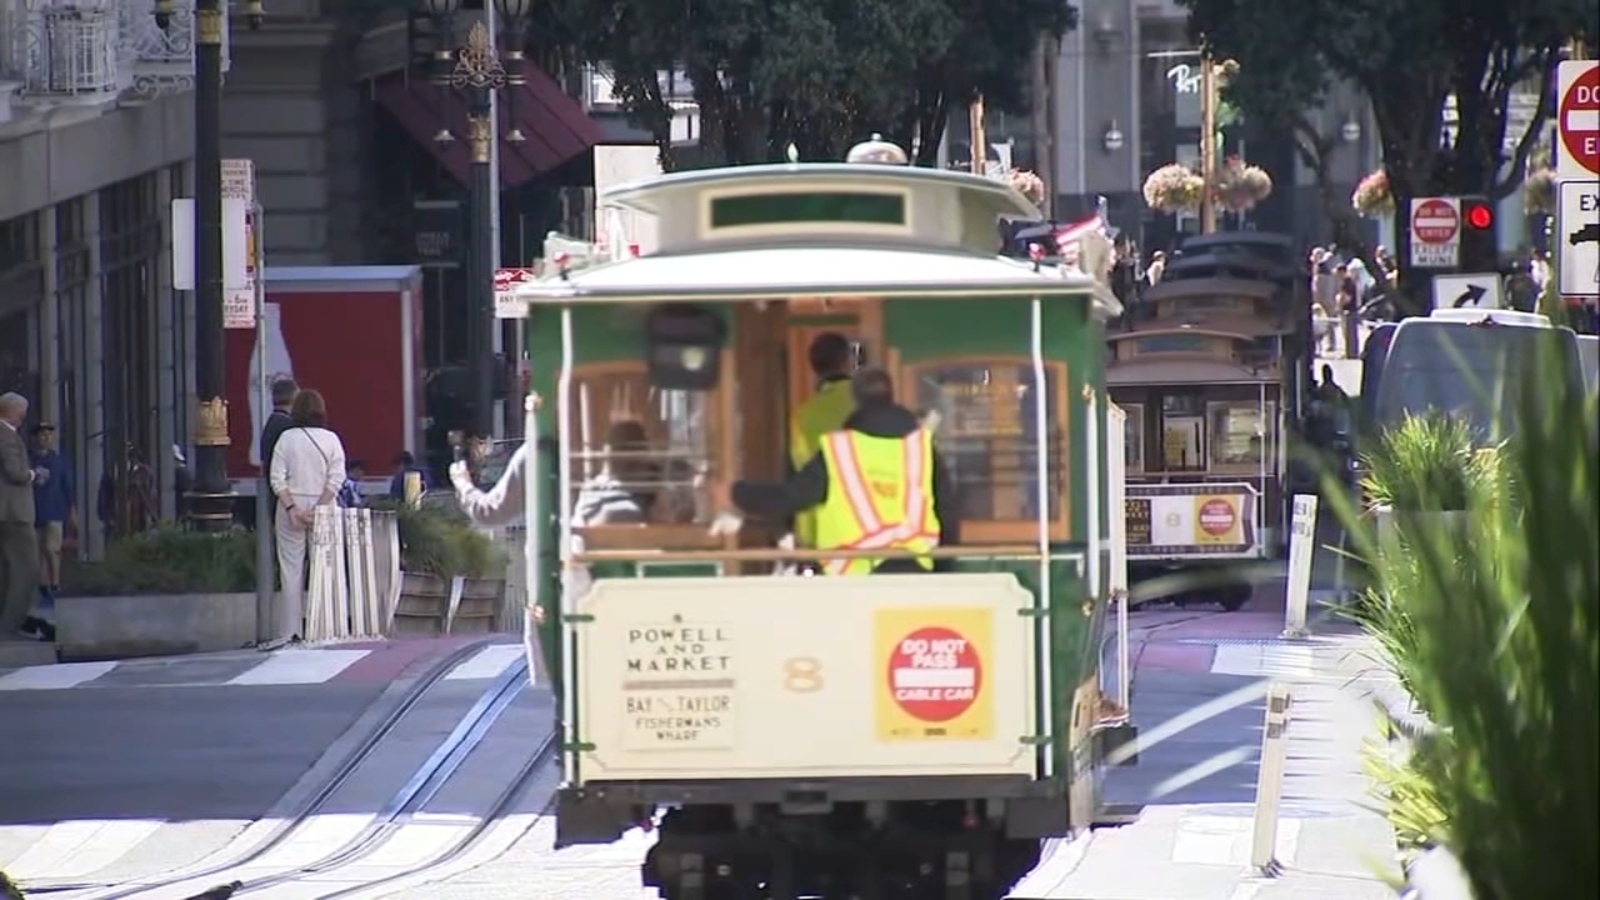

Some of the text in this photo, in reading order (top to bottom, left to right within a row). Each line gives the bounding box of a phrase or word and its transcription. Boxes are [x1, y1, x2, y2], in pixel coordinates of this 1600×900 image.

[629, 628, 732, 643] POWELL
[656, 643, 704, 655] AND
[902, 639, 968, 654] DO NOT
[627, 656, 732, 671] MARKET
[912, 654, 958, 668] PASS
[783, 657, 824, 694] 8
[896, 689, 974, 701] CABLE CAR
[626, 697, 652, 713] BAY
[677, 695, 731, 711] TAYLOR
[635, 717, 721, 729] FISHERMANS
[656, 730, 701, 741] WHARF
